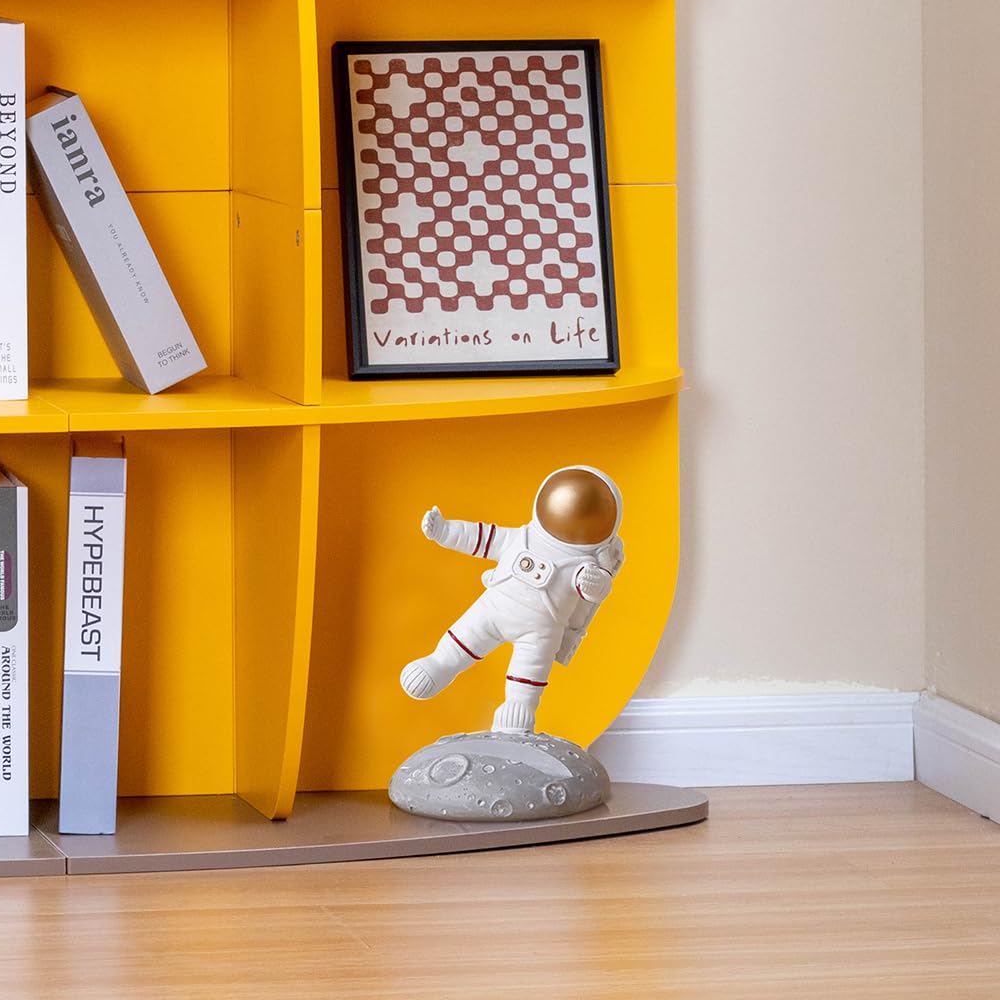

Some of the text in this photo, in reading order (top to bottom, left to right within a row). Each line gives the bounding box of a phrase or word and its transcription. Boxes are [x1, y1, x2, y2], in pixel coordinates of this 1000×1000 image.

[0, 93, 17, 195] BEYOND
[50, 114, 106, 208] ianra
[107, 223, 149, 304] YOU ALREADY KNOW
[157, 341, 183, 359] BEGUN
[158, 348, 191, 368] TO THINK
[373, 316, 600, 348] Variations on Life
[81, 505, 104, 661] HYPEBEAST
[1, 646, 12, 782] AROUND THE WORLD
